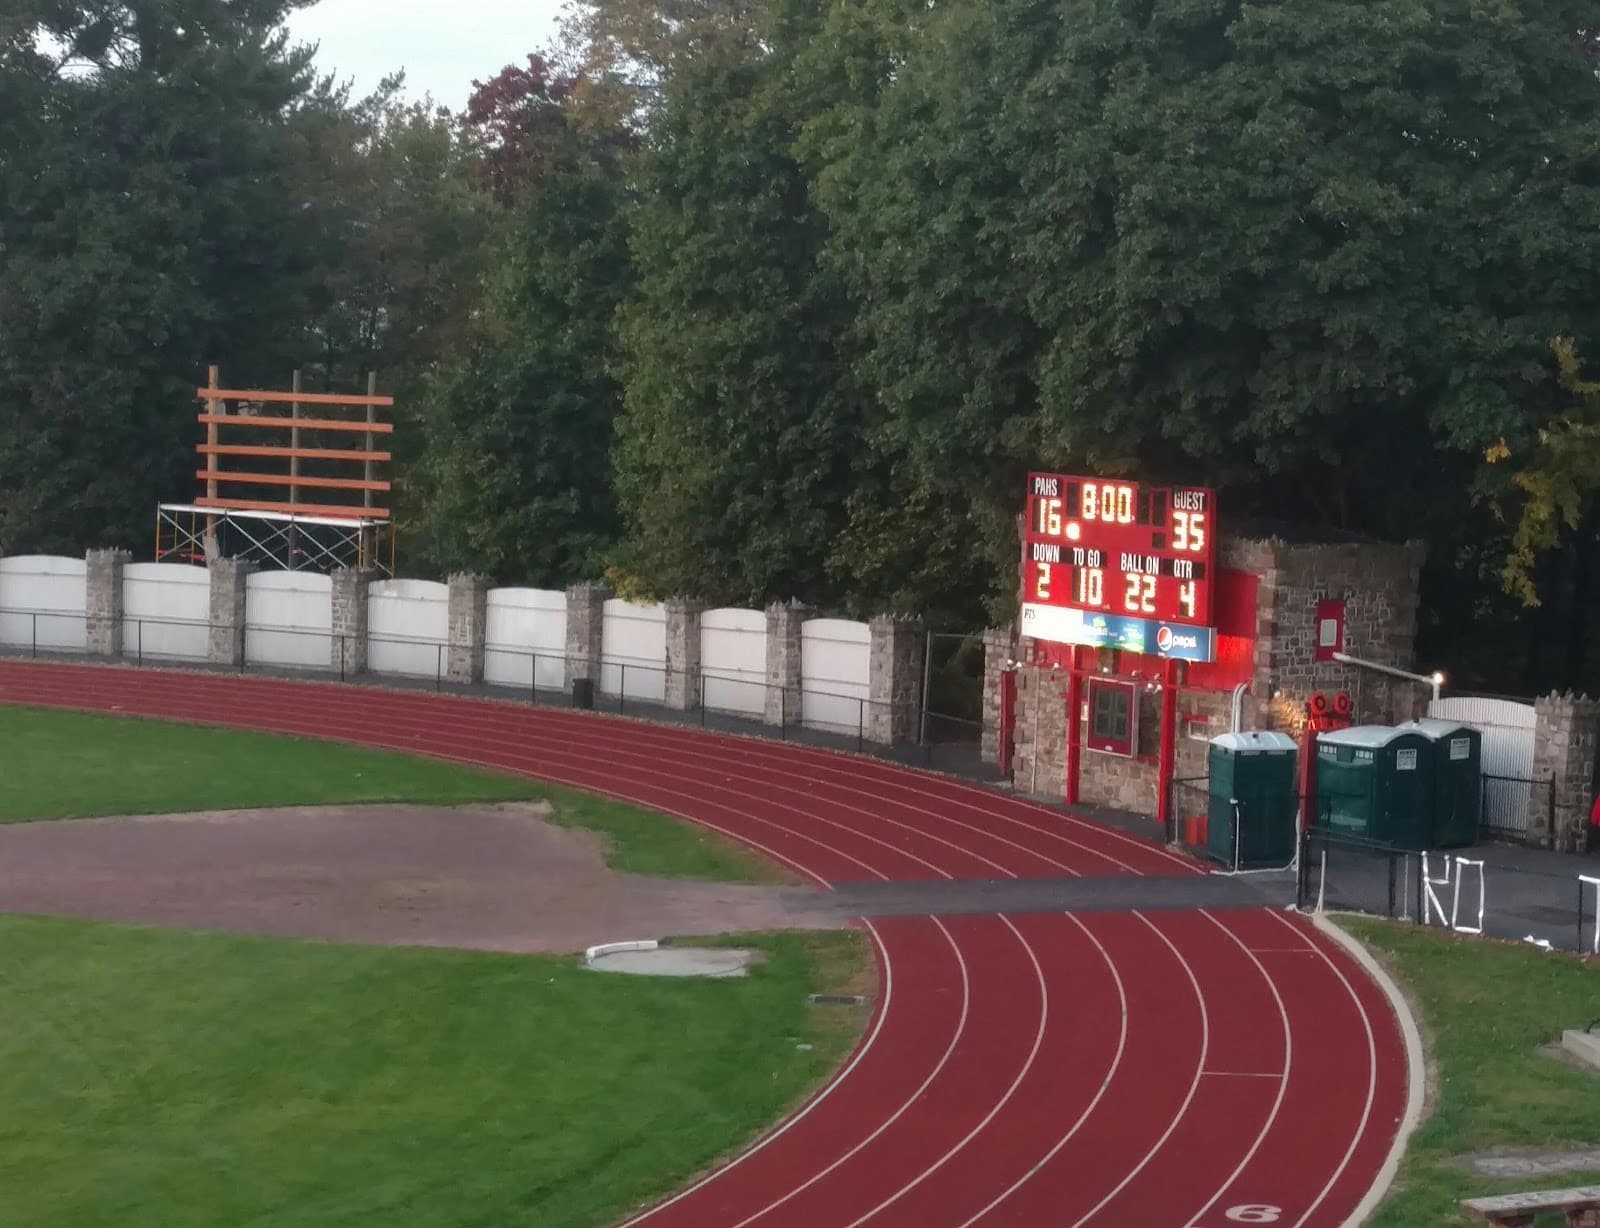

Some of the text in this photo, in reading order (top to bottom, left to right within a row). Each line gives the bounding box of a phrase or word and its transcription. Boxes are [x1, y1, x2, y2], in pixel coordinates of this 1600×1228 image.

[1034, 477, 1058, 497] PAHS
[1174, 492, 1205, 511] GUEST
[1039, 498, 1062, 536] 16
[1172, 511, 1205, 551] 35
[1033, 543, 1060, 563] DOWN
[1073, 547, 1101, 568] TO GO
[1120, 553, 1160, 576] BALL ON
[1173, 559, 1193, 579] QTR
[1037, 563, 1051, 598] 2
[1079, 568, 1102, 605] 10
[1125, 573, 1157, 613] 22
[1180, 581, 1195, 617] 4
[1172, 634, 1197, 648] pepsi
[1225, 1204, 1283, 1223] 6
